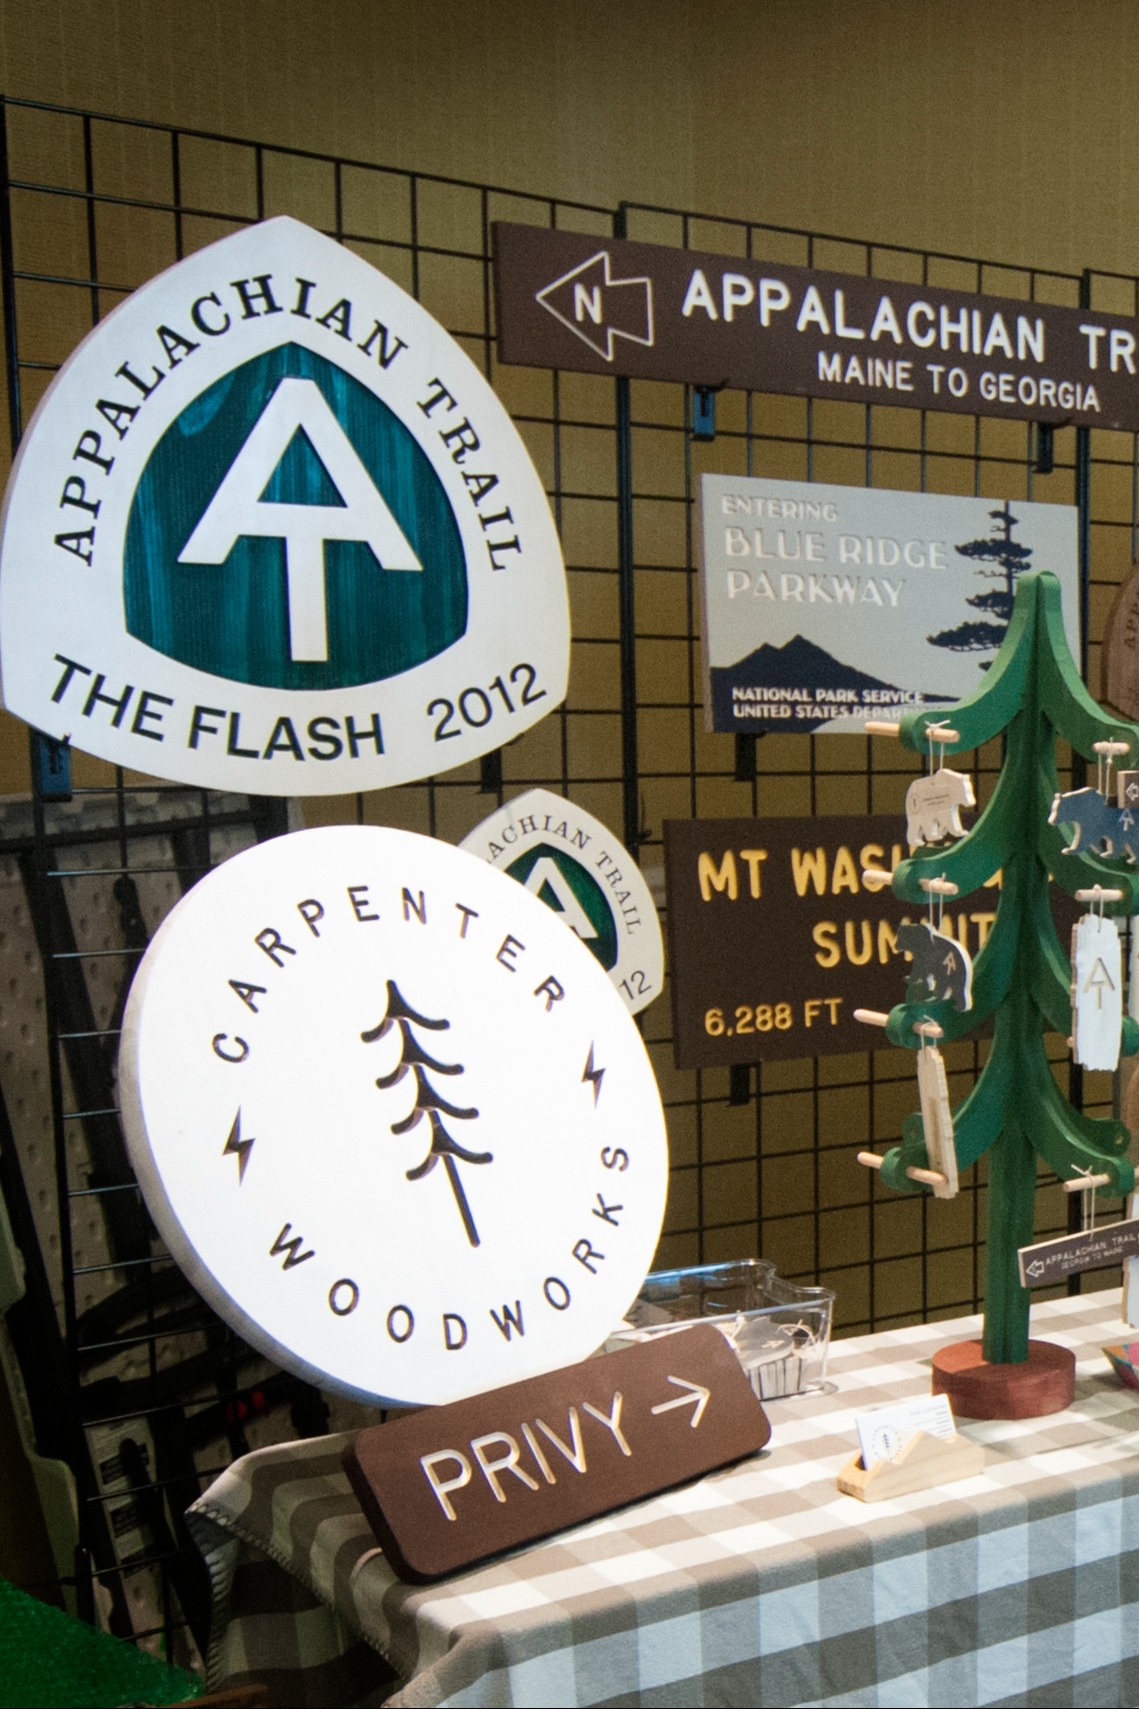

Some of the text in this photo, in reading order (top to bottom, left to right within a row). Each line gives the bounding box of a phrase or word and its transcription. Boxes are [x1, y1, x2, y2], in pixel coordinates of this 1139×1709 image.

[574, 283, 602, 325] N
[682, 268, 1046, 364] APPALACHIAN
[817, 351, 1101, 414] MAINE TO GEORGIA
[54, 273, 523, 572] APPALACHIAN TRAIL
[721, 493, 839, 524] ENTERING
[724, 526, 949, 571] BLUE RIDGE
[726, 568, 908, 608] PARKWAY
[50, 653, 548, 762] THE FLASH 2012
[732, 686, 926, 705] NATIONAL PARK SERVICE
[733, 703, 792, 719] UNITED
[795, 704, 852, 720] STATES
[487, 814, 642, 935] ACHIAN TRAIL
[697, 849, 768, 901] MT
[211, 884, 566, 1065] CARPENTER
[705, 997, 843, 1037] 6,288 FT
[268, 1145, 631, 1351] WOODWORKS
[1045, 1233, 1137, 1266] APPALACHIAN TRAIL
[419, 1390, 633, 1522] PRIVY
